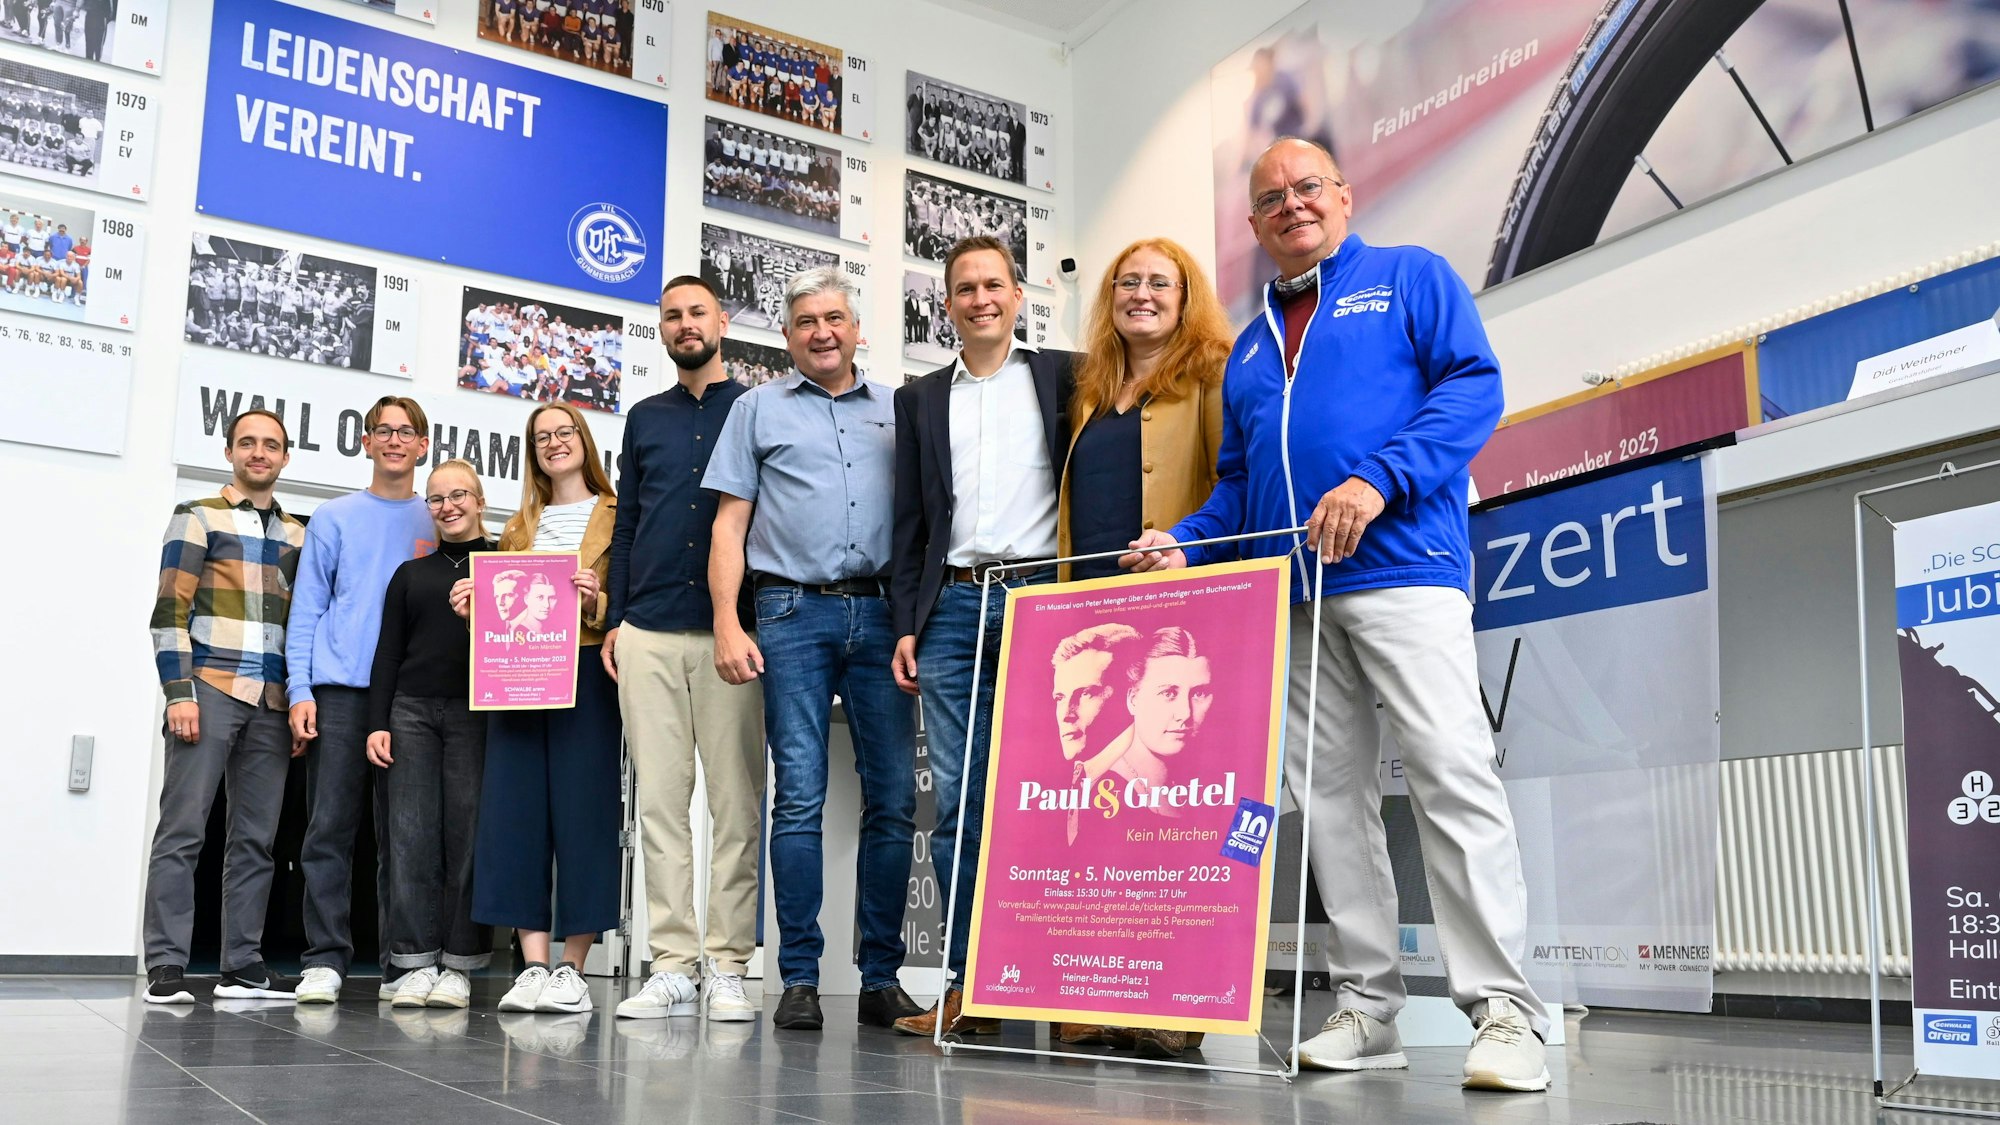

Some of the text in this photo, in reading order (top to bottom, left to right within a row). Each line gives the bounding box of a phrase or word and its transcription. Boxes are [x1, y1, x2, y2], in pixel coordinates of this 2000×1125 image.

[131, 13, 148, 27] DM
[646, 35, 656, 47] EL
[847, 56, 867, 72] 1971
[240, 21, 541, 138] LEIDENSCHAFT
[852, 93, 861, 104] EL
[1371, 38, 1539, 145] Fahrradreifen
[115, 90, 147, 111] 1979
[1030, 110, 1049, 126] 1973
[120, 129, 134, 144] EP
[235, 93, 423, 182] VEREINT.
[118, 145, 133, 159] EV
[1034, 145, 1045, 157] DM
[846, 156, 867, 174] 1976
[1502, 91, 1572, 244] SCHWALBE
[850, 194, 862, 206] DM
[1030, 206, 1050, 222] 1977
[102, 218, 134, 238] 1988
[1035, 241, 1045, 252] DP
[105, 266, 123, 281] DM
[577, 257, 636, 281] GUMMERSBACH
[845, 260, 866, 276] 1982
[383, 274, 409, 292] 1991
[1031, 303, 1051, 318] 1983
[1333, 301, 1390, 318] arena
[386, 319, 401, 332] DM
[628, 323, 655, 340] 2009
[1036, 321, 1046, 331] DM
[1037, 333, 1045, 343] DP
[1872, 344, 1968, 380] Didi Weithöner
[632, 364, 649, 377] EHF
[200, 386, 320, 452] WLL
[1619, 426, 1659, 454] 2023
[1469, 480, 1689, 605] zert
[1035, 604, 1046, 612] Ein
[1047, 602, 1072, 611] Musical
[1085, 600, 1102, 608] Peter
[1103, 597, 1128, 606] Menger
[1129, 595, 1144, 603] über
[1144, 593, 1158, 601] den
[1126, 826, 1218, 842] Kein Märchen
[1228, 838, 1259, 854] arena
[1009, 865, 1231, 885] Sonntag 5. November 2023
[1044, 888, 1187, 900] Einlass: 15:30 Uhr Beginn: 17 Uhr
[1946, 886, 1989, 908] Sa.
[997, 900, 1239, 914] Vorverkauf: www.paul-und-gretel.de/tickets-gummersbach
[1015, 913, 1215, 927] Familientickets mit Sonderpreisen ab 5 Personen!
[1047, 927, 1175, 941] Abendkasse ebenfalls geöffnet.
[1268, 941, 1320, 956] messng.
[1533, 946, 1629, 961] AVTTENTION
[1653, 945, 1710, 960] MENNEKES
[1052, 954, 1163, 971] SCHWALBE arena
[1062, 972, 1150, 986] Heiner-Brand-Platz 1
[1059, 985, 1149, 999] 51643 Gummersbach
[1172, 992, 1235, 1005] mengermusic
[1927, 1031, 1970, 1042] arena
